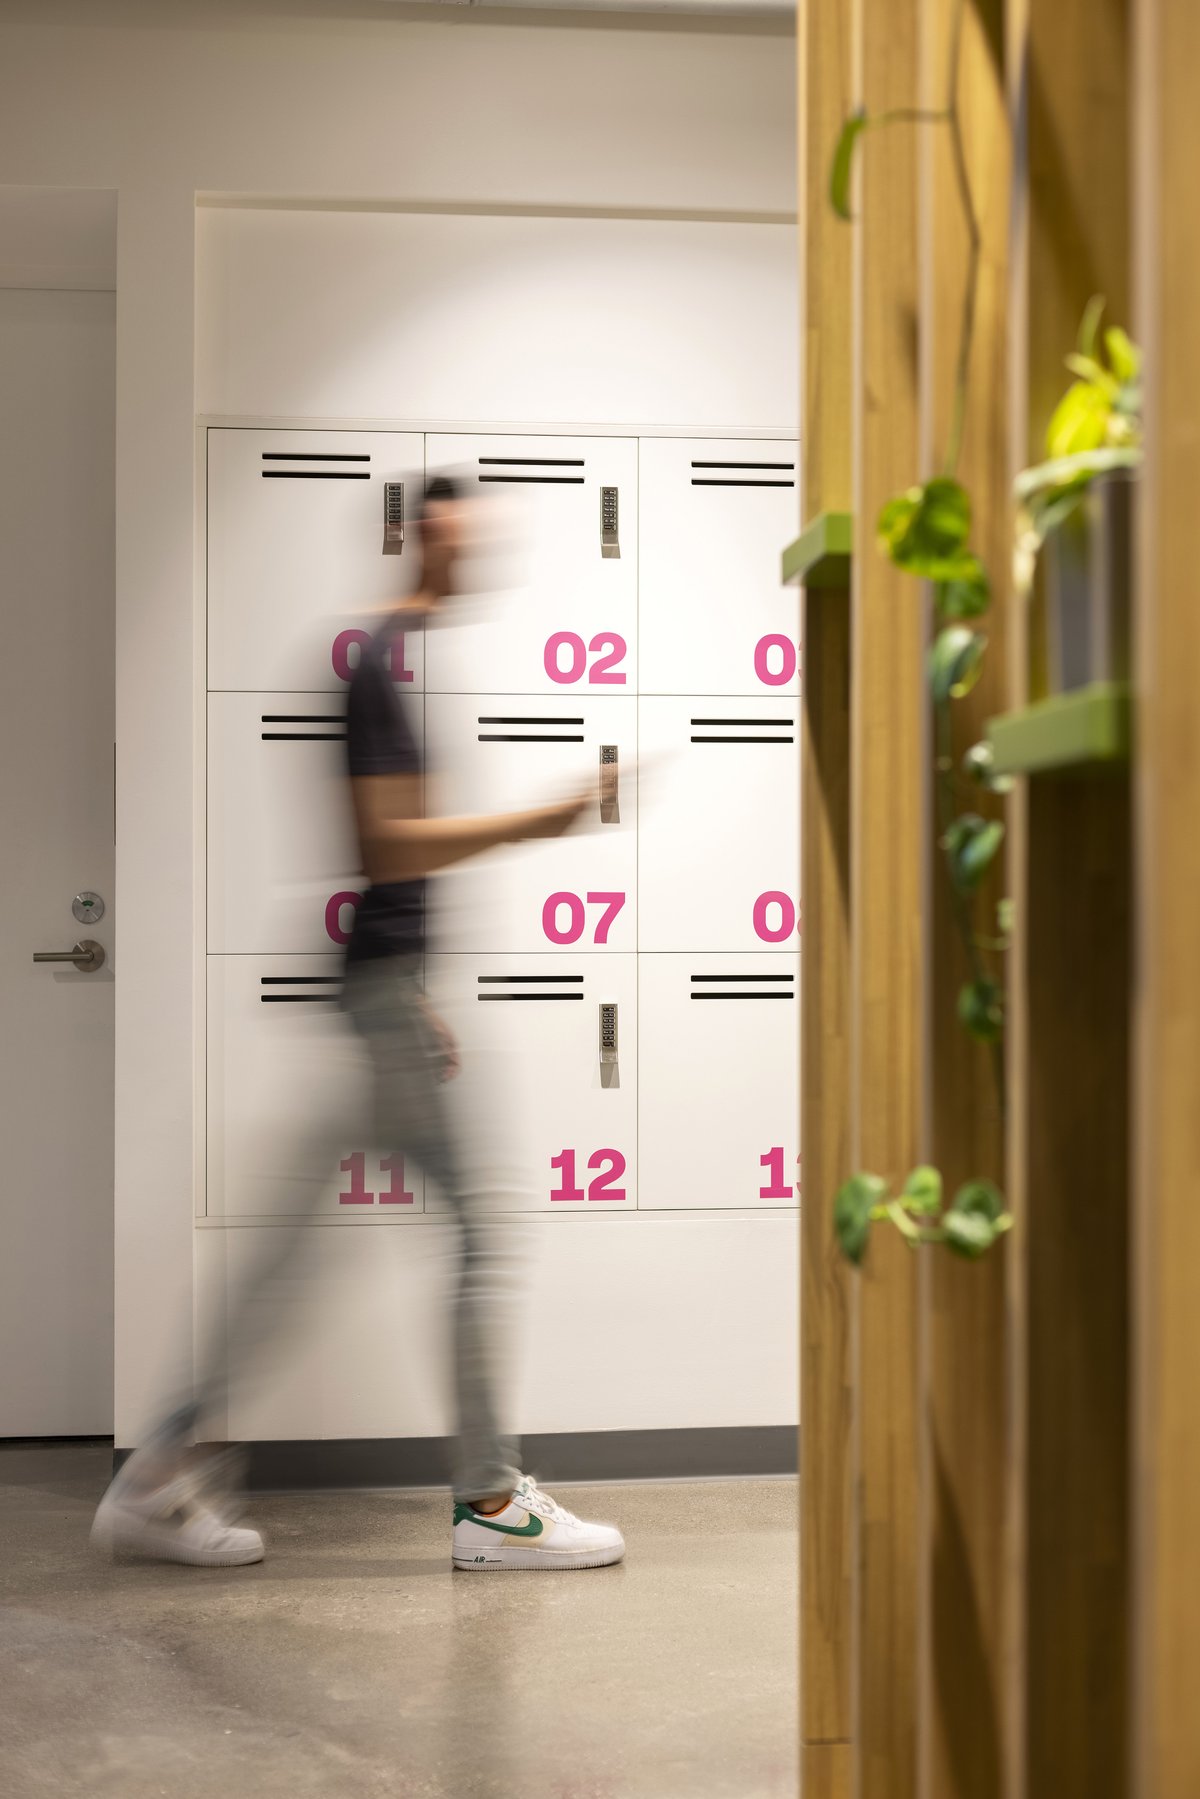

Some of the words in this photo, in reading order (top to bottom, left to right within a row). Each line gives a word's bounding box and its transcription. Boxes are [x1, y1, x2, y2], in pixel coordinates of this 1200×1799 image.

[332, 629, 414, 683] 01
[543, 631, 627, 685] 02
[754, 633, 802, 687] 0
[542, 891, 626, 945] 07
[753, 890, 802, 943] 0
[339, 1151, 414, 1204] 11
[550, 1148, 627, 1201] 12
[760, 1146, 802, 1199] 1
